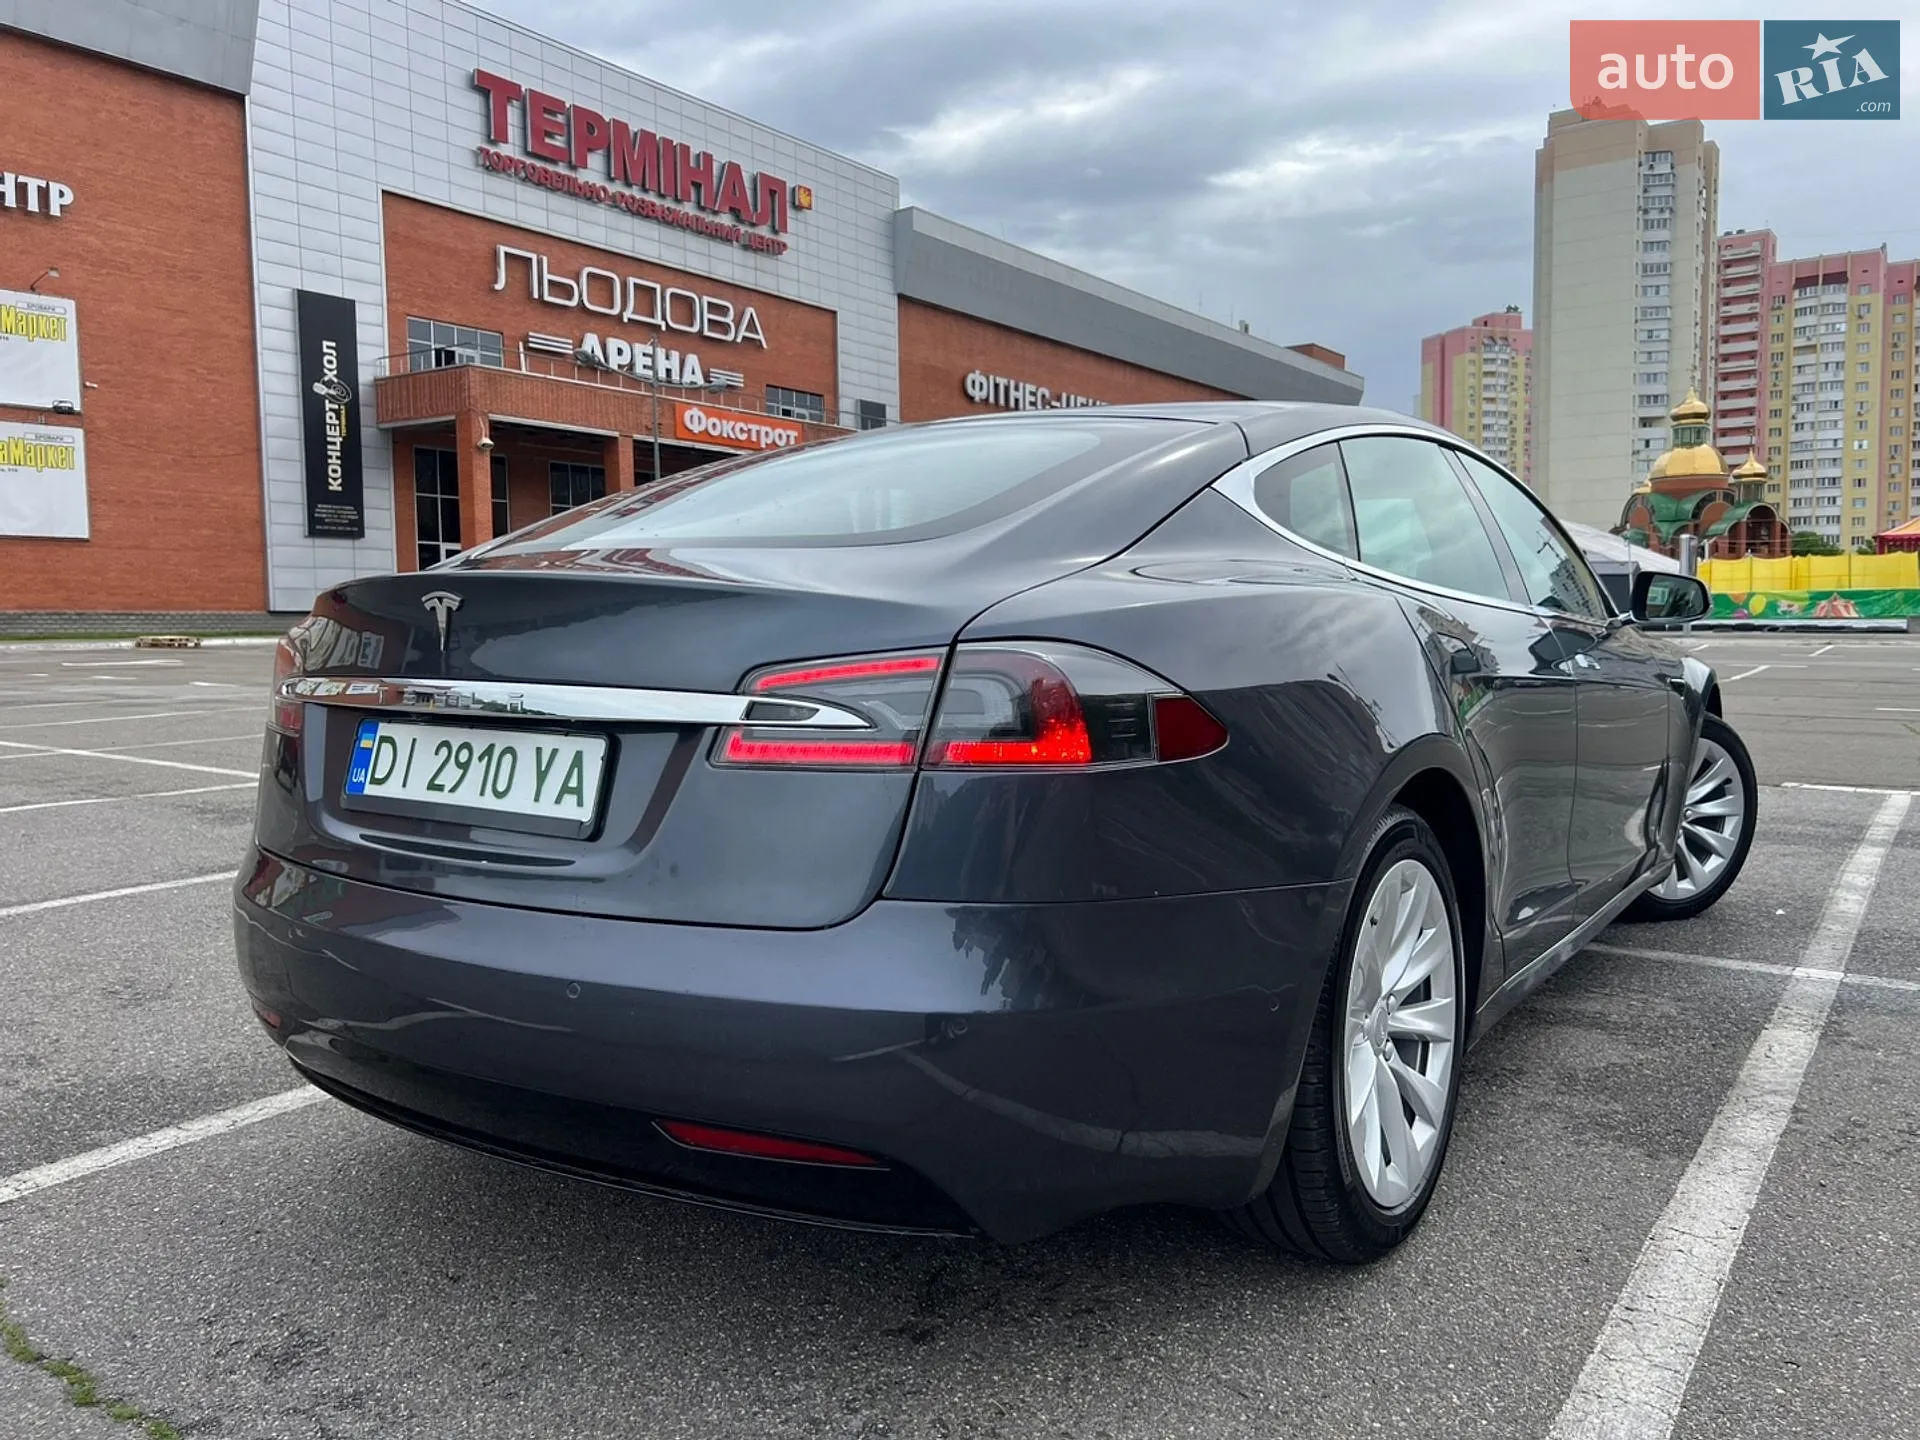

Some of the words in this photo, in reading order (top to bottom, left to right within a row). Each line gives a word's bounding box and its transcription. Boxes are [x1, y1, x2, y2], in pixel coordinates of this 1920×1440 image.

[473, 68, 788, 233] ТЕРМІНАЛ
[746, 230, 788, 255] ЦЕНТР
[493, 244, 768, 349] ЛЬОДОВА
[323, 340, 339, 382] ХОЛ
[580, 332, 704, 386] АРЕНА
[325, 399, 342, 491] КОНЦЕРТ
[683, 407, 798, 448] Фокстрот
[352, 768, 366, 783] UA
[368, 735, 417, 788] DI
[426, 740, 518, 799] 2910
[533, 747, 584, 807] YA
